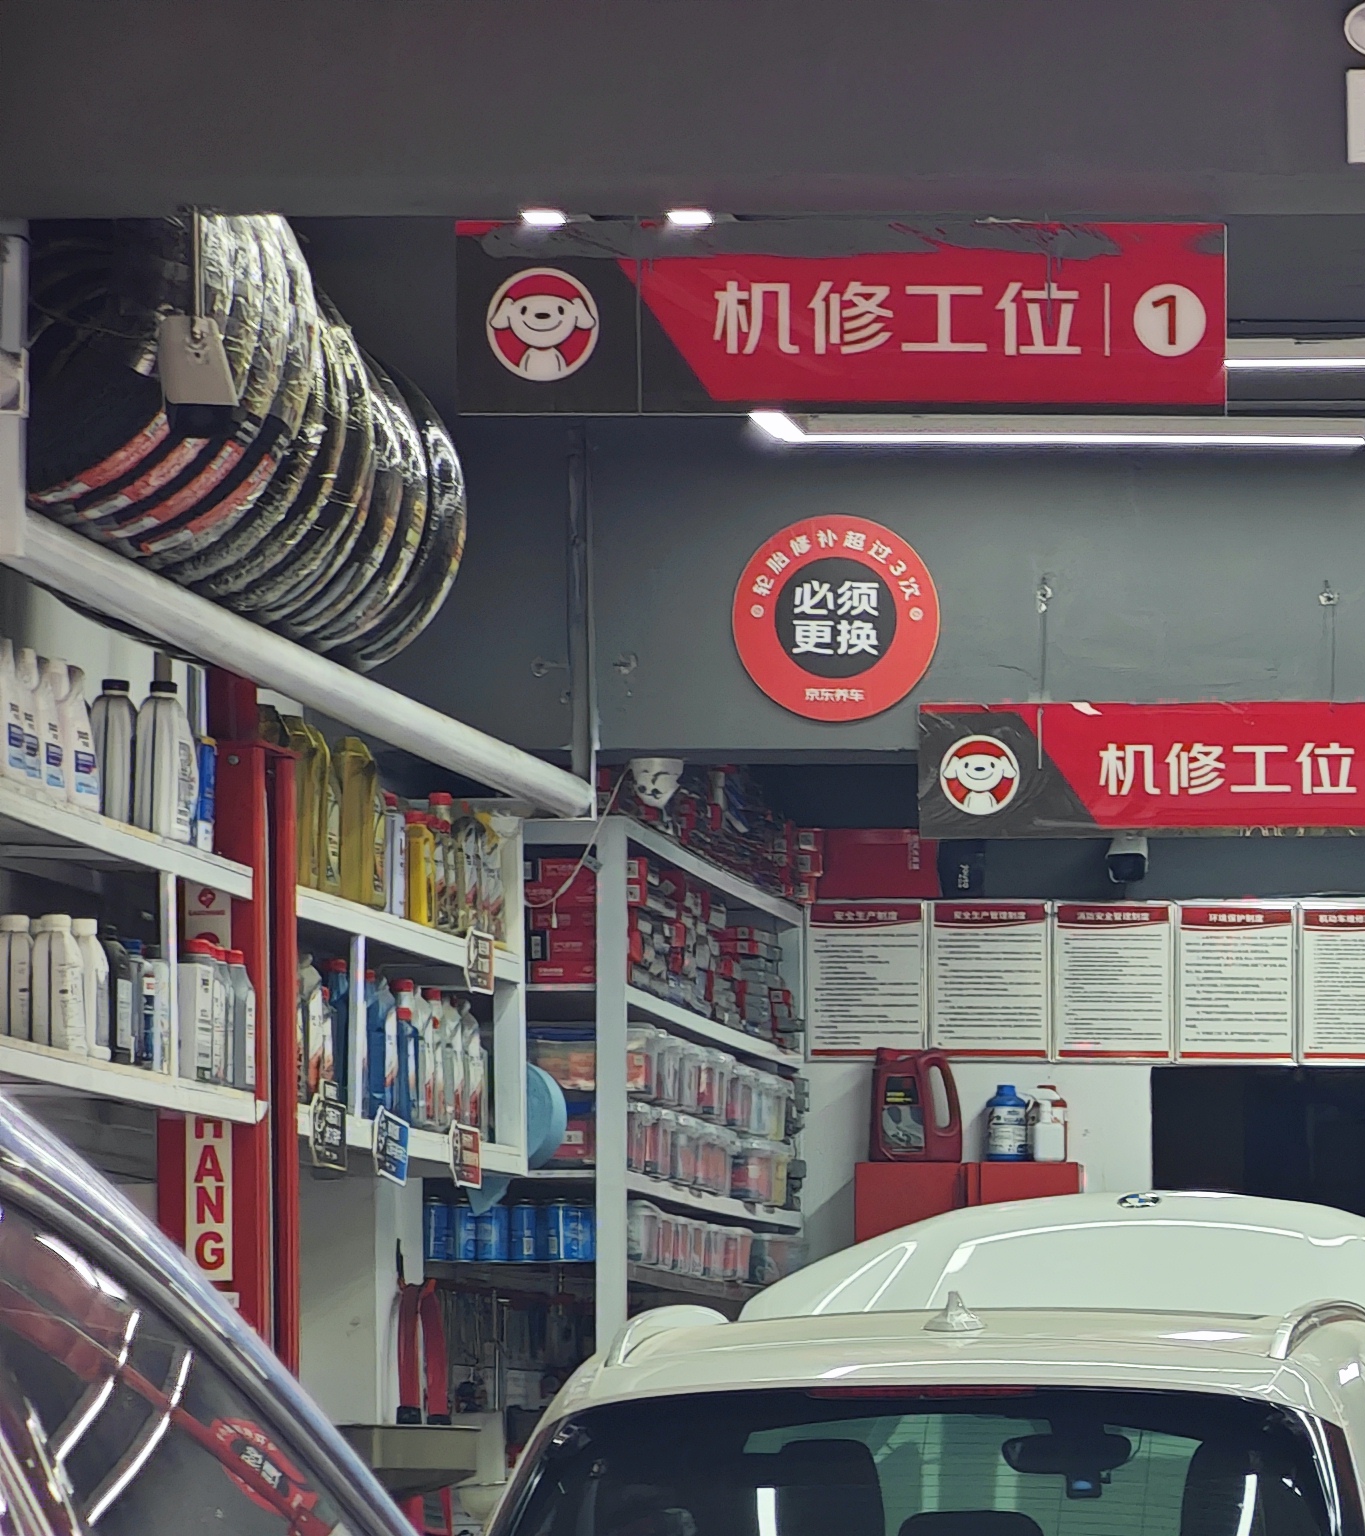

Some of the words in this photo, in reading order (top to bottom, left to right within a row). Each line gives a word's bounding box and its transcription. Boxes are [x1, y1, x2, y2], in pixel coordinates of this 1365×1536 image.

[712, 279, 1083, 356] 机修工位
[752, 528, 921, 601] 轮胎修补超过3次
[793, 580, 880, 617] 必须
[791, 619, 880, 656] 更换
[804, 687, 865, 702] 京东养车
[1099, 741, 1357, 796] 机修工位
